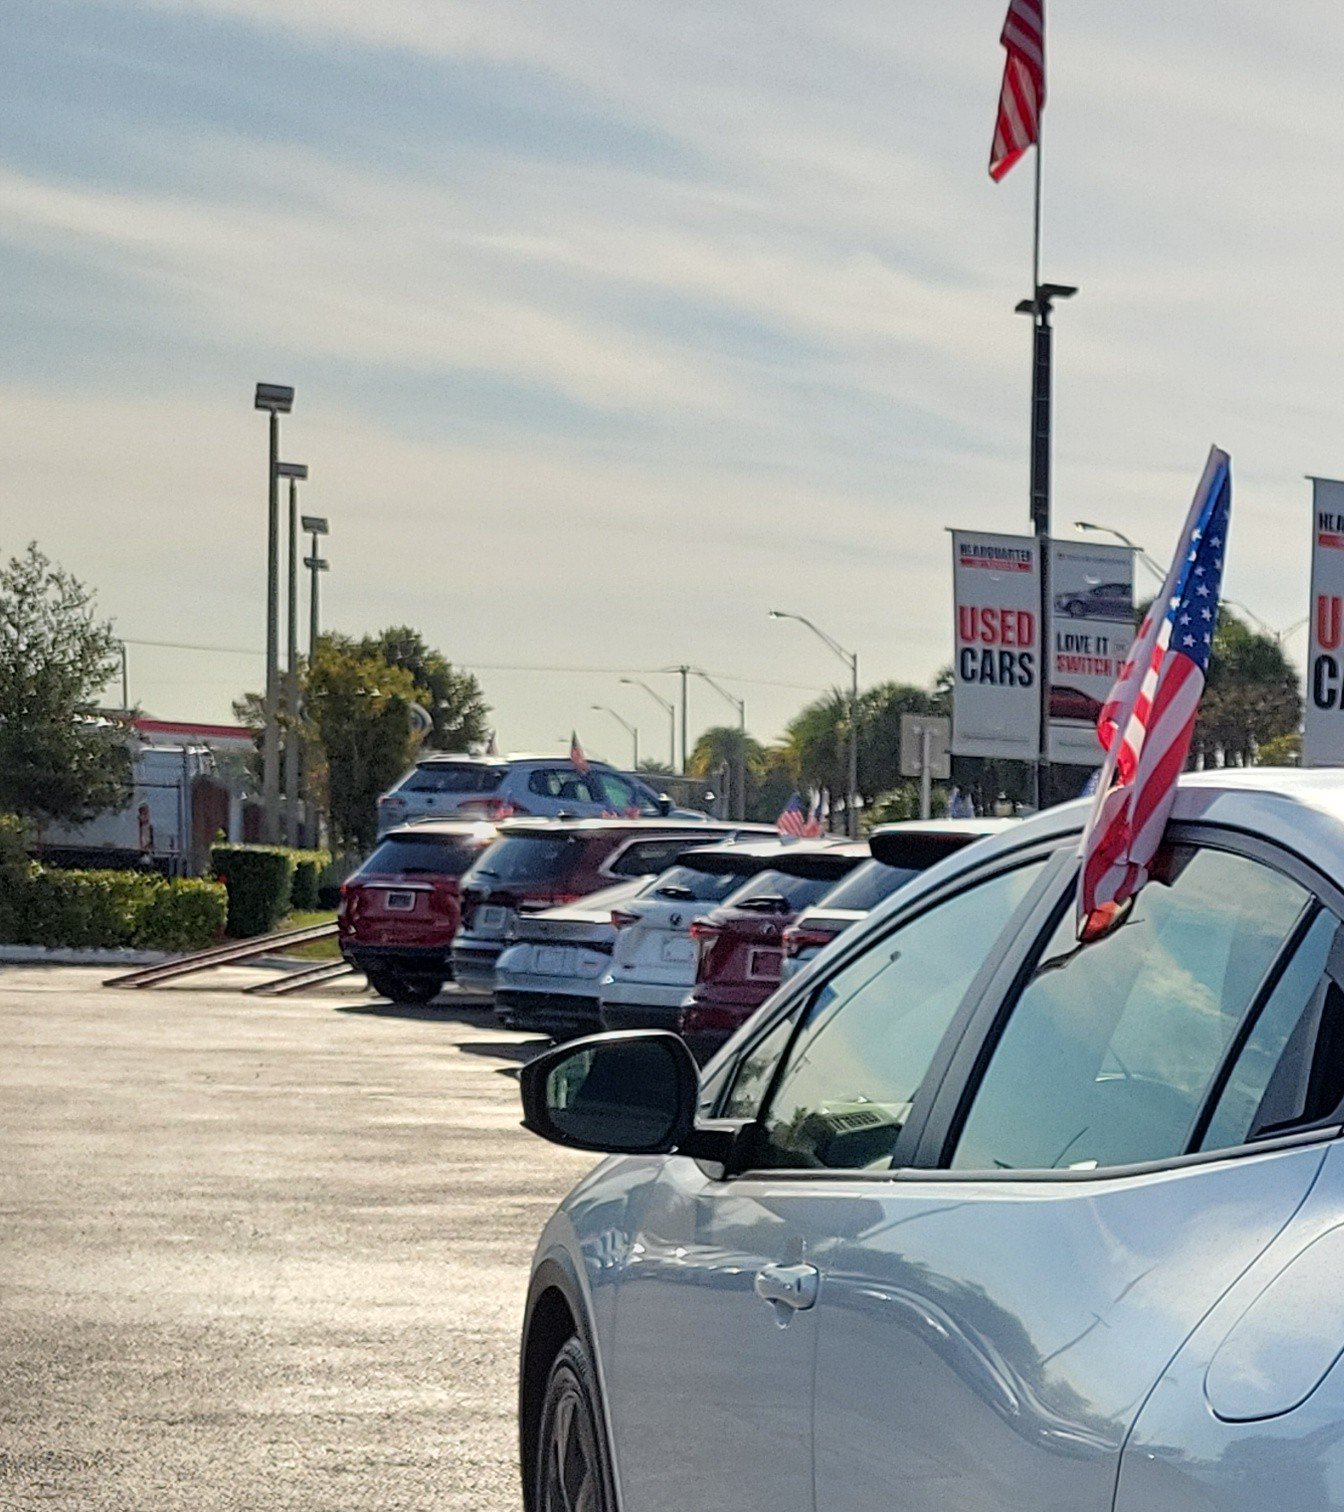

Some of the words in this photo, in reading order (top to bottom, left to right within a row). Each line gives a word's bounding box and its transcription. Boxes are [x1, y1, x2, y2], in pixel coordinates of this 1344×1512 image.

[959, 606, 1035, 648] USED
[1057, 631, 1091, 654] LOVE
[1096, 636, 1110, 655] IT
[959, 647, 1035, 687] CARS
[1056, 654, 1113, 677] SWITCH
